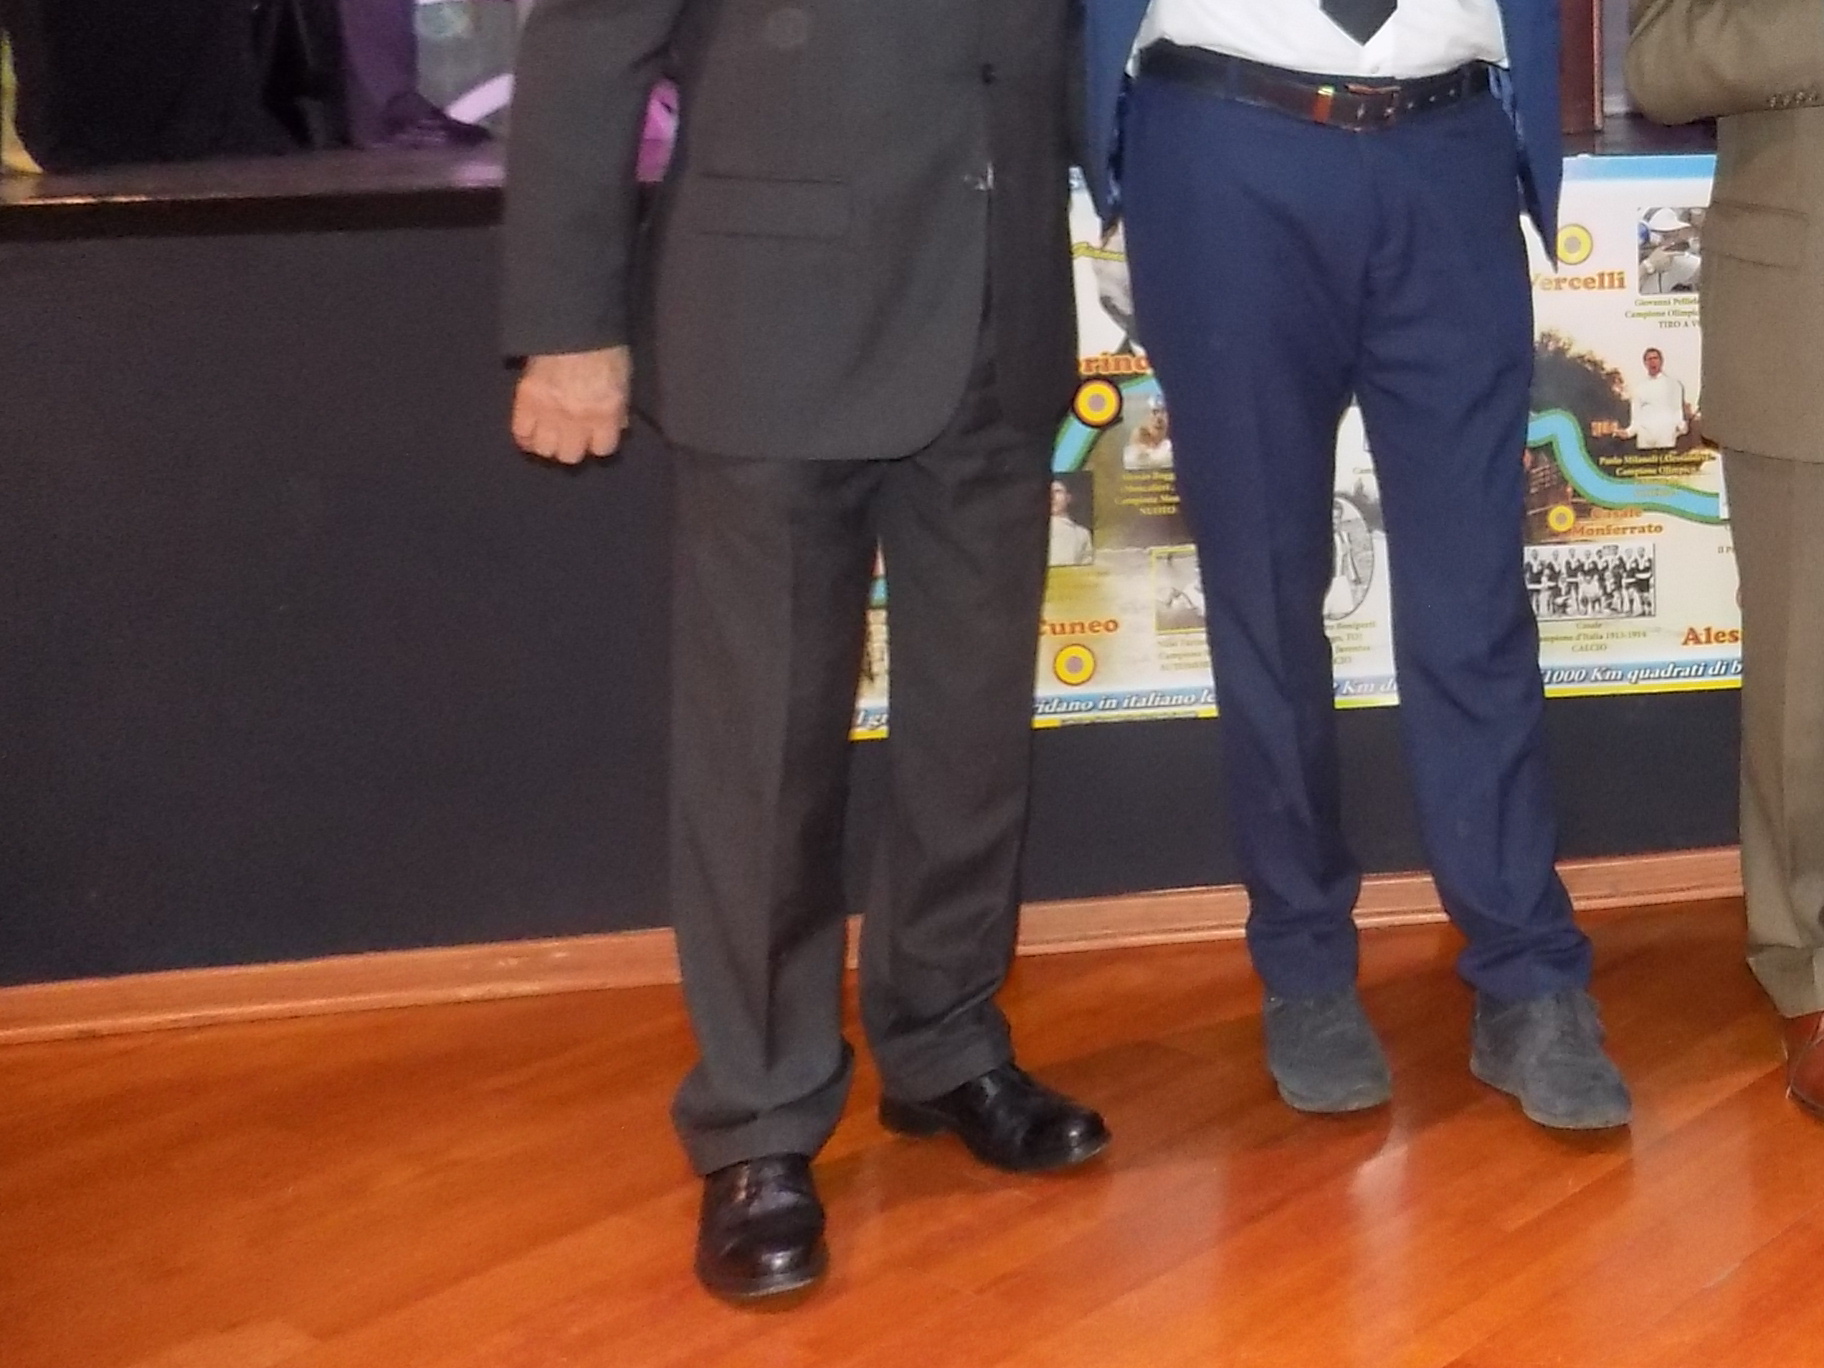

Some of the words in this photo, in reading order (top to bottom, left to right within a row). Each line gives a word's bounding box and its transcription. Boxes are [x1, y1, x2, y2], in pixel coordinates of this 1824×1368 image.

[1590, 670, 1623, 682] Km
[1627, 663, 1705, 684] quadrati
[1708, 661, 1728, 676] di
[1098, 695, 1117, 710] in
[1122, 691, 1196, 709] italiano
